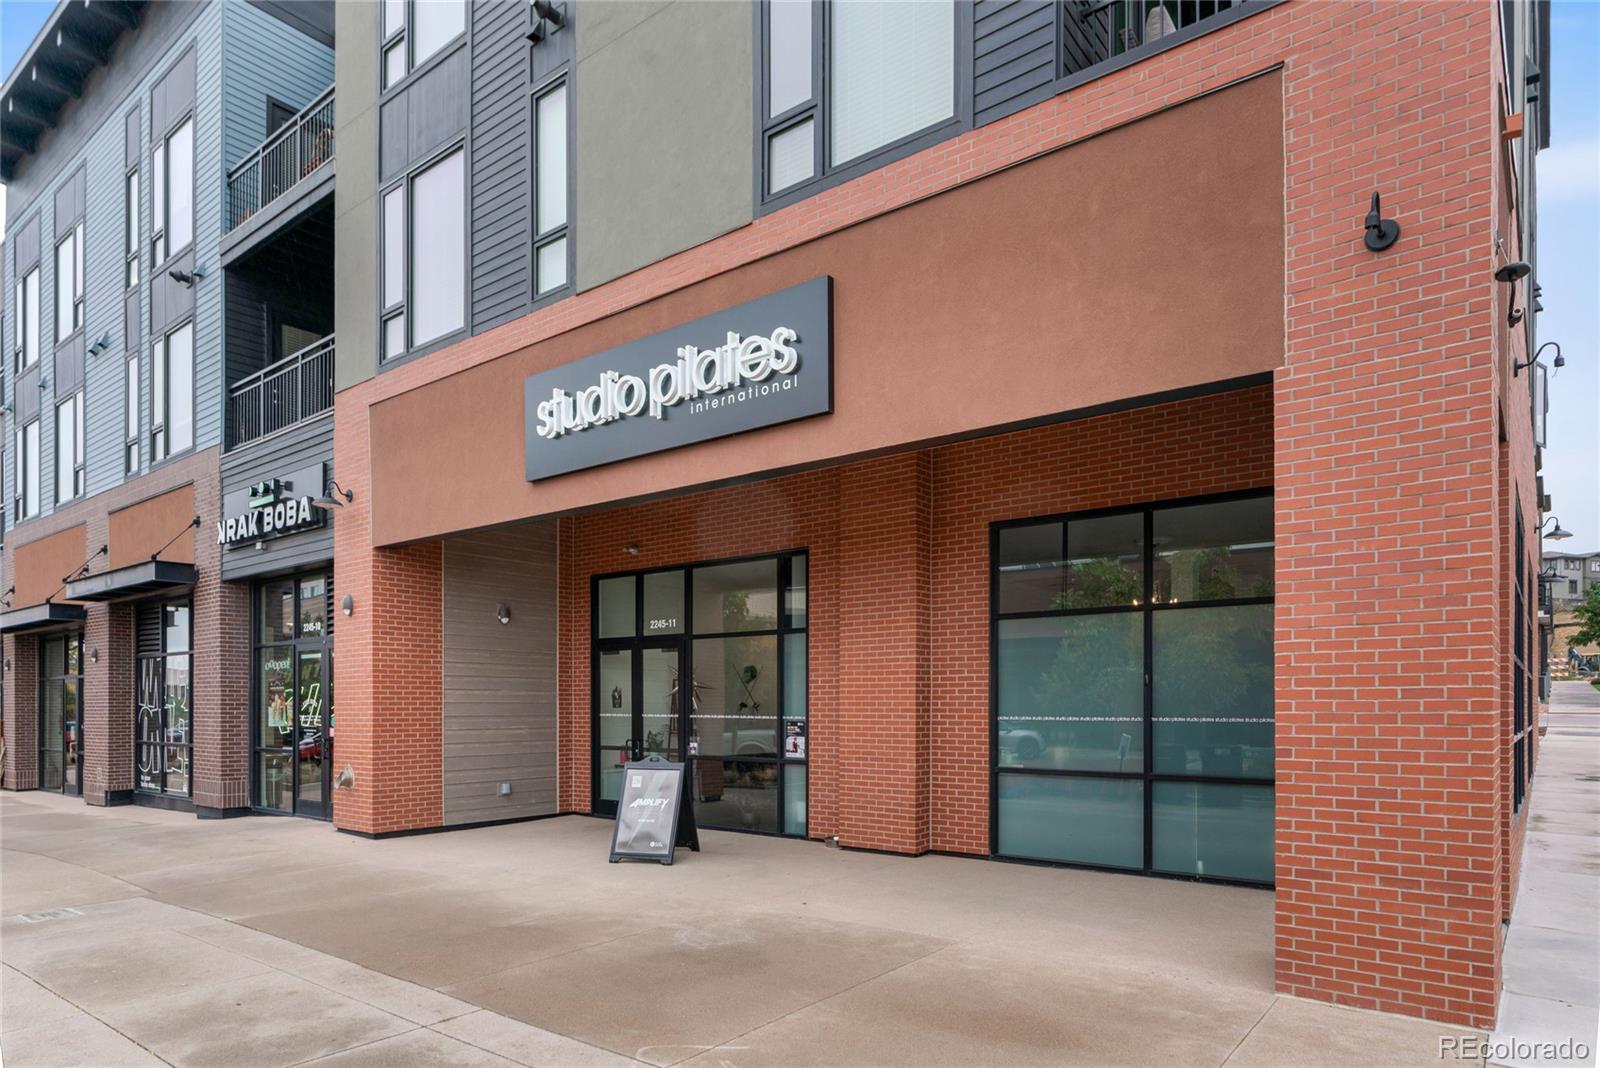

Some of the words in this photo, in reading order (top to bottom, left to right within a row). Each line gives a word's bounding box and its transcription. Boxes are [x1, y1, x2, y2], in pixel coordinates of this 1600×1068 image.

[536, 369, 647, 439] studio
[649, 326, 799, 420] pilates
[690, 374, 798, 415] international
[263, 496, 311, 533] BOBA
[649, 618, 676, 629] 2245-11
[629, 798, 670, 809] AMPLIFY
